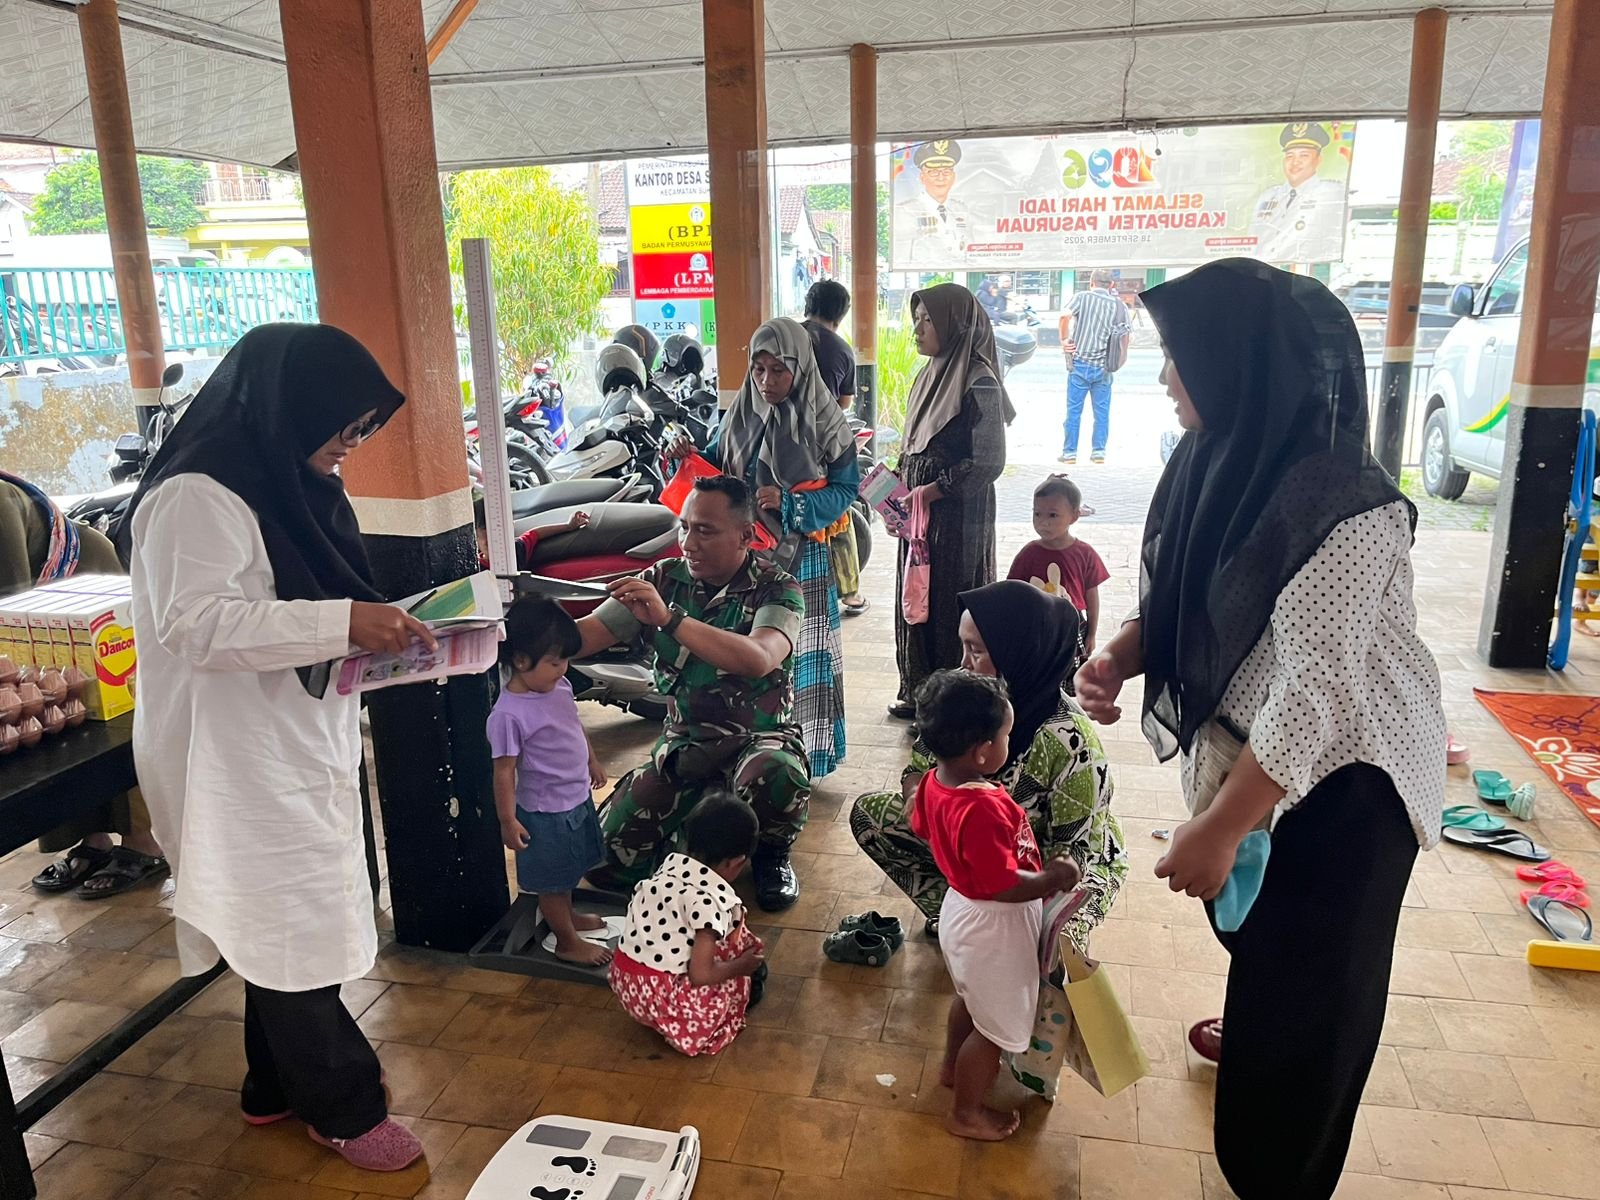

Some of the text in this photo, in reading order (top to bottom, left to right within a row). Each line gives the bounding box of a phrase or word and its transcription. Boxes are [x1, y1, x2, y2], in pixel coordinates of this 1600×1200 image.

[635, 172, 674, 187] KANTOR
[677, 170, 702, 185] DESA
[640, 287, 670, 295] LEMBAGA
